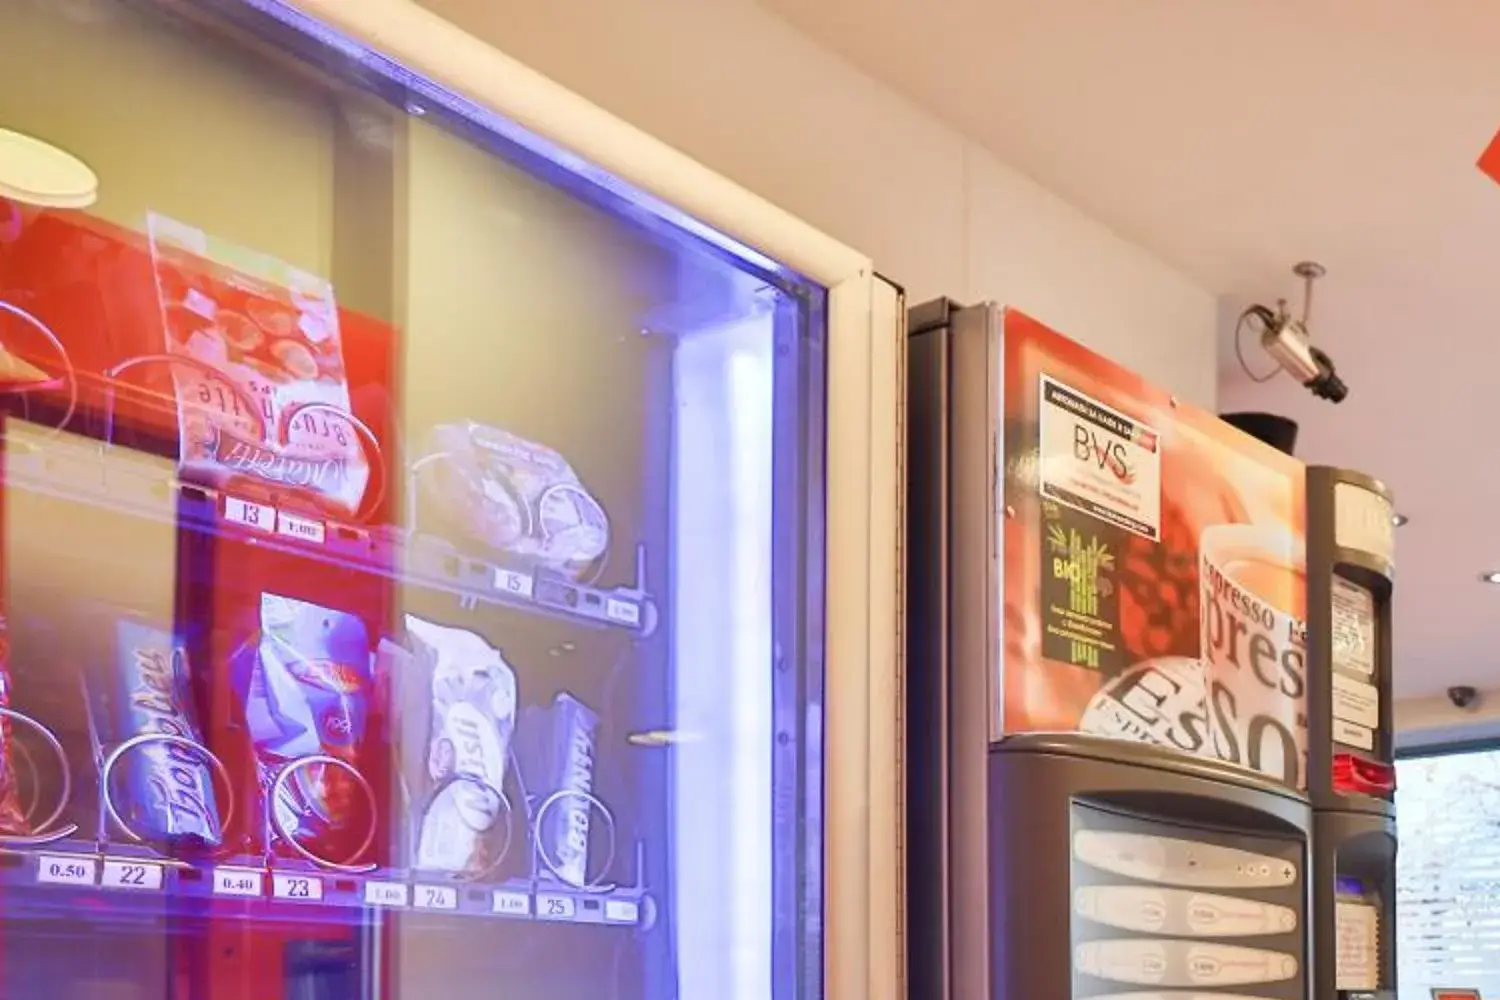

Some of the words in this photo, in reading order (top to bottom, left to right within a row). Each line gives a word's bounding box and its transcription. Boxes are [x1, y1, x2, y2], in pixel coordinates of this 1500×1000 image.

[1073, 423, 1128, 480] BVS
[243, 503, 259, 524] 13
[1053, 557, 1082, 584] BIO
[506, 575, 521, 592] 15
[50, 863, 85, 878] 0.50
[119, 866, 145, 885] 22
[287, 879, 309, 897] 23
[427, 889, 445, 907] 24
[548, 899, 565, 915] 25
